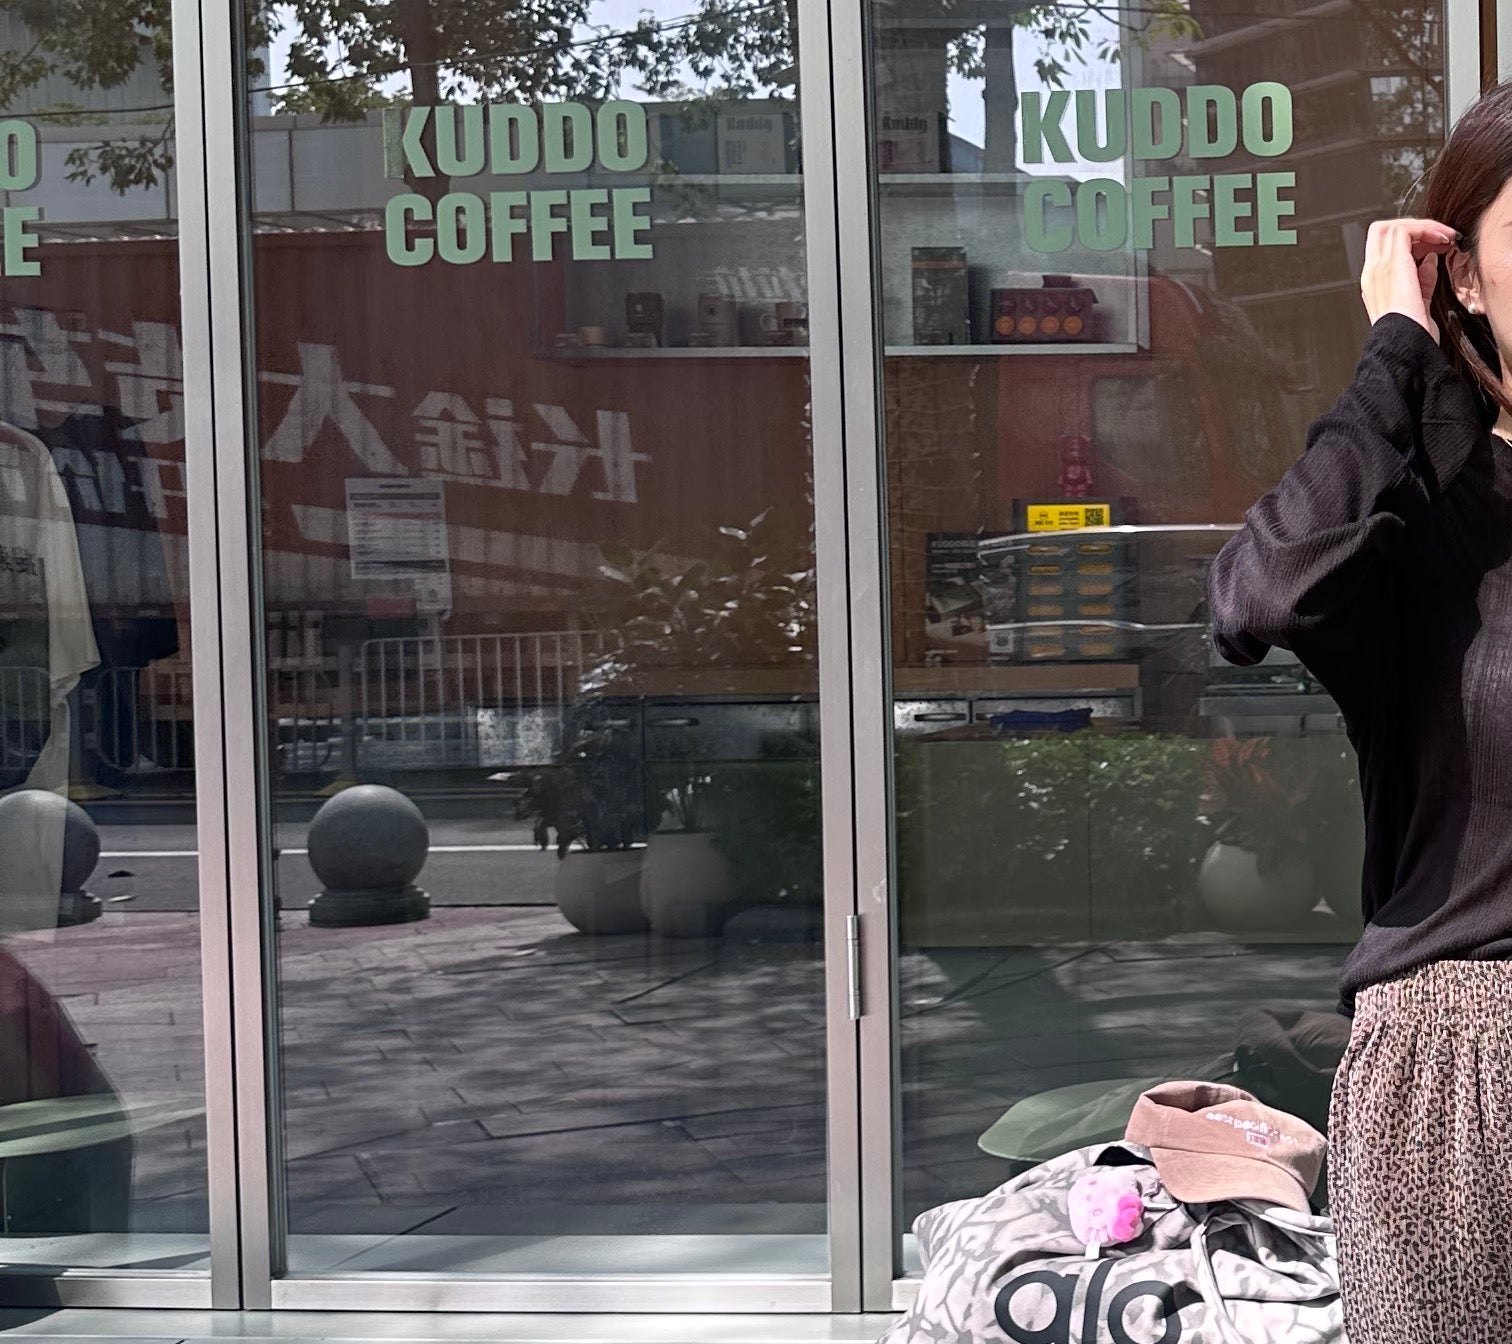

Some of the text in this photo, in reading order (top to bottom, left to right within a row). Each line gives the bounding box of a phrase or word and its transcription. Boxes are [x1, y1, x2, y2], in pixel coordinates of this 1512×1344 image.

[382, 101, 648, 179] KUDDO
[1021, 82, 1293, 163] KUDDO
[385, 187, 654, 267] COFFEE
[1023, 172, 1298, 253] COFFEE
